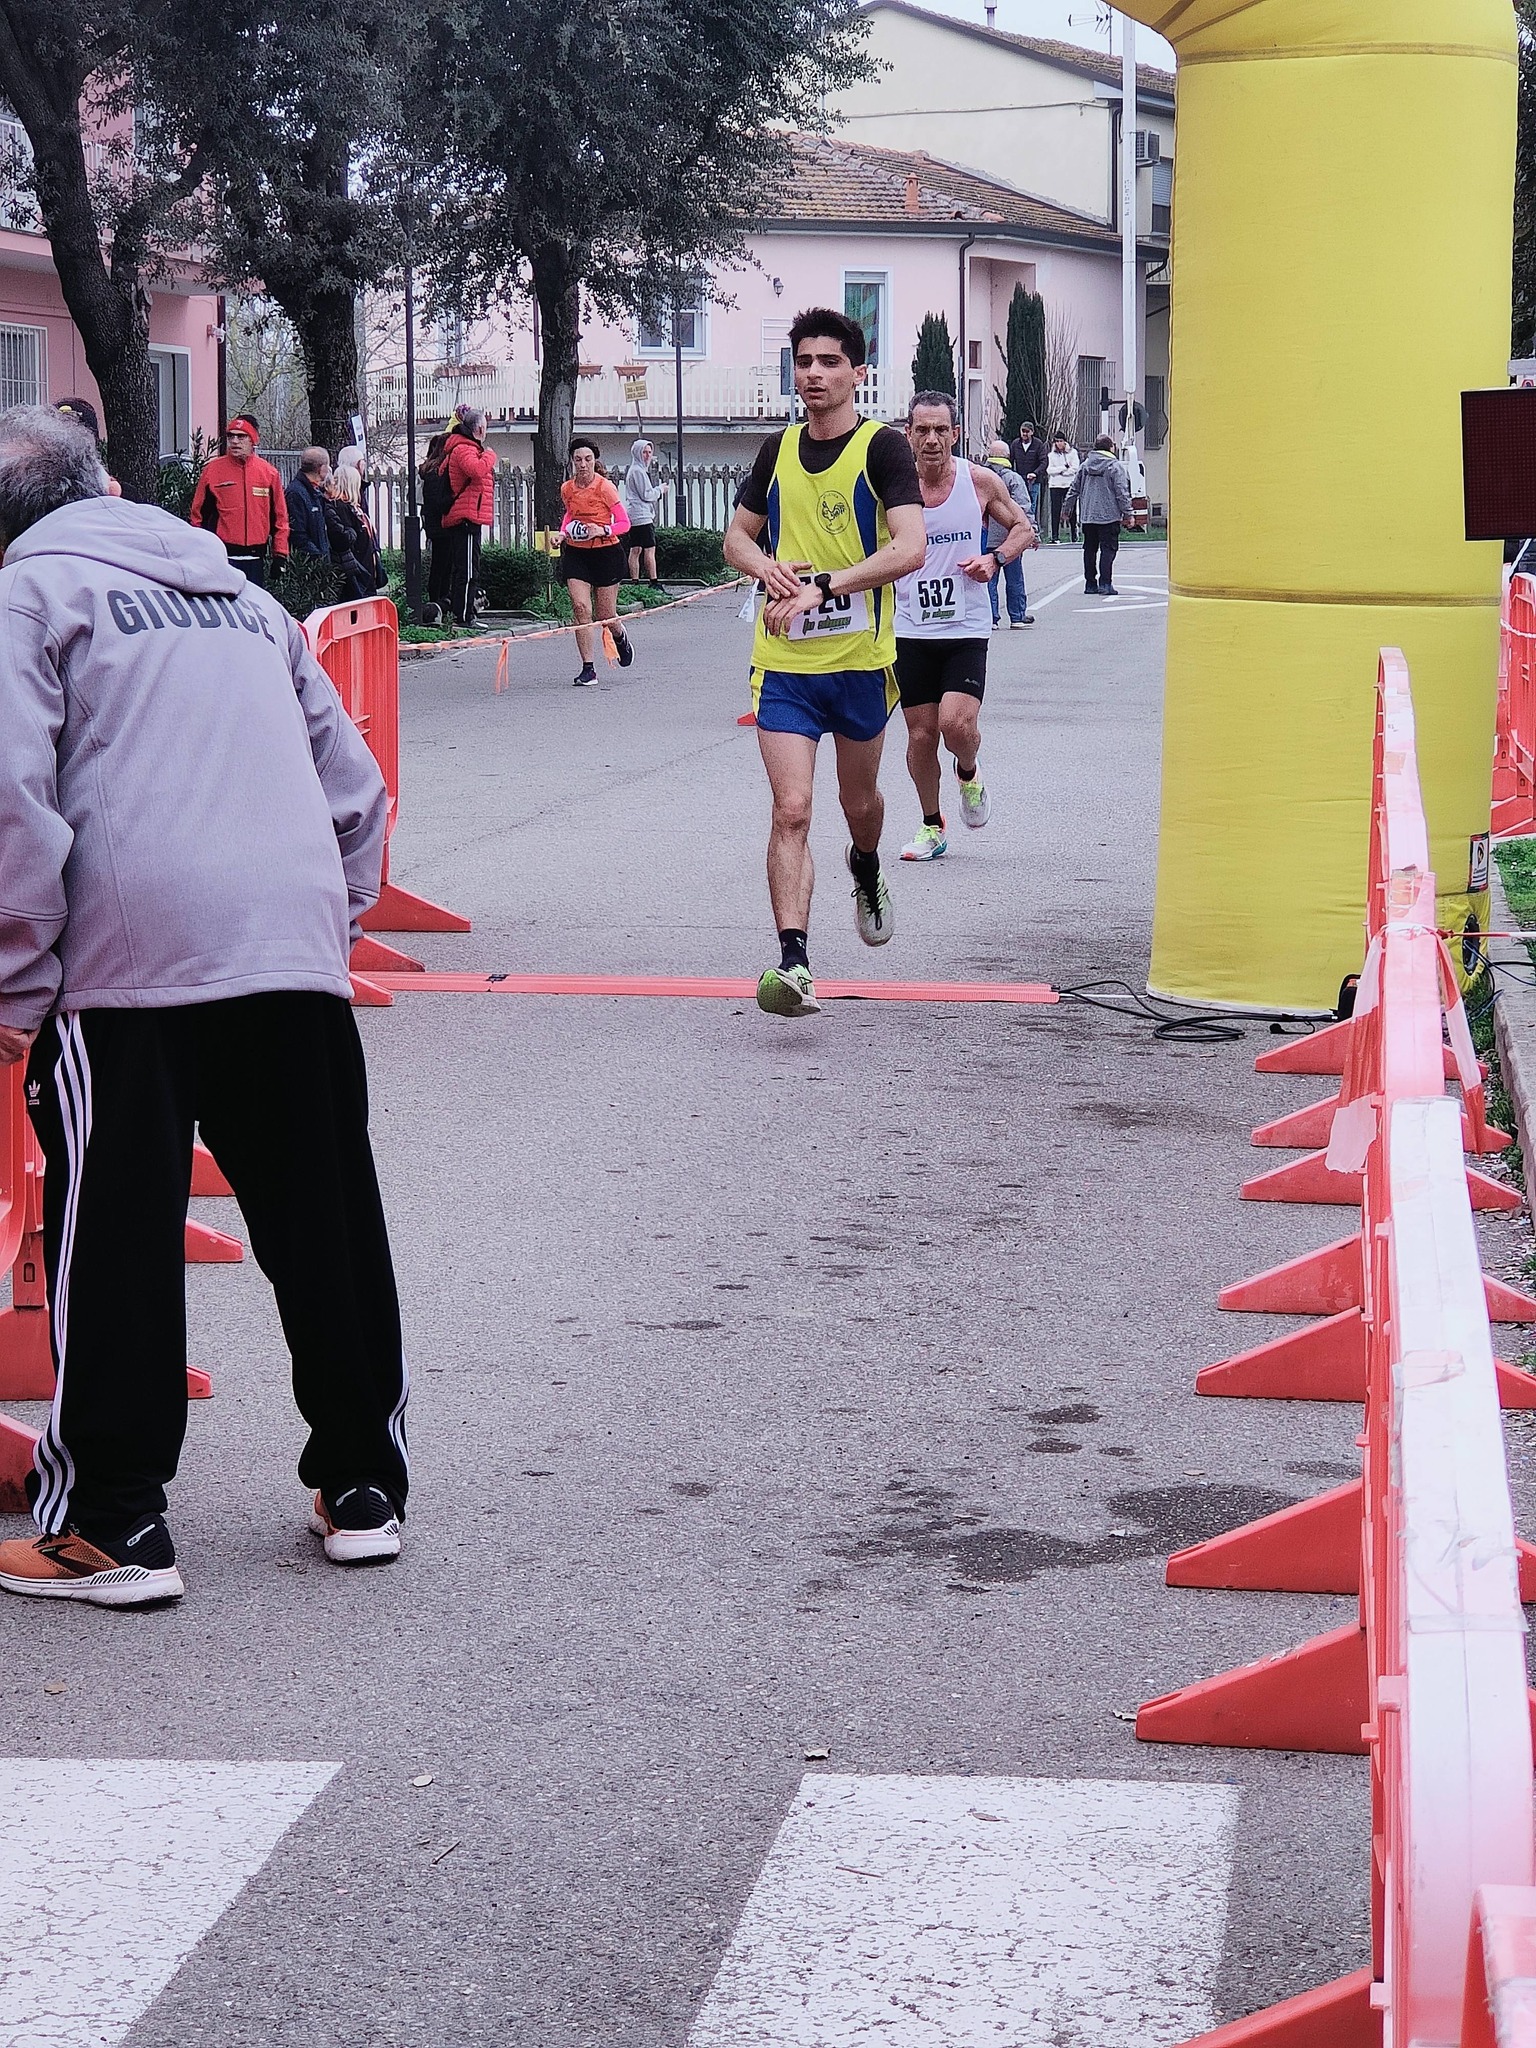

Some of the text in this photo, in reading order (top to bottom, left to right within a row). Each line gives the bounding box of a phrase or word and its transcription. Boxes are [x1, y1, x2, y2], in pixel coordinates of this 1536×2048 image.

[926, 531, 972, 545] hesina
[918, 578, 956, 609] 532
[107, 590, 276, 645] GIUDICE
